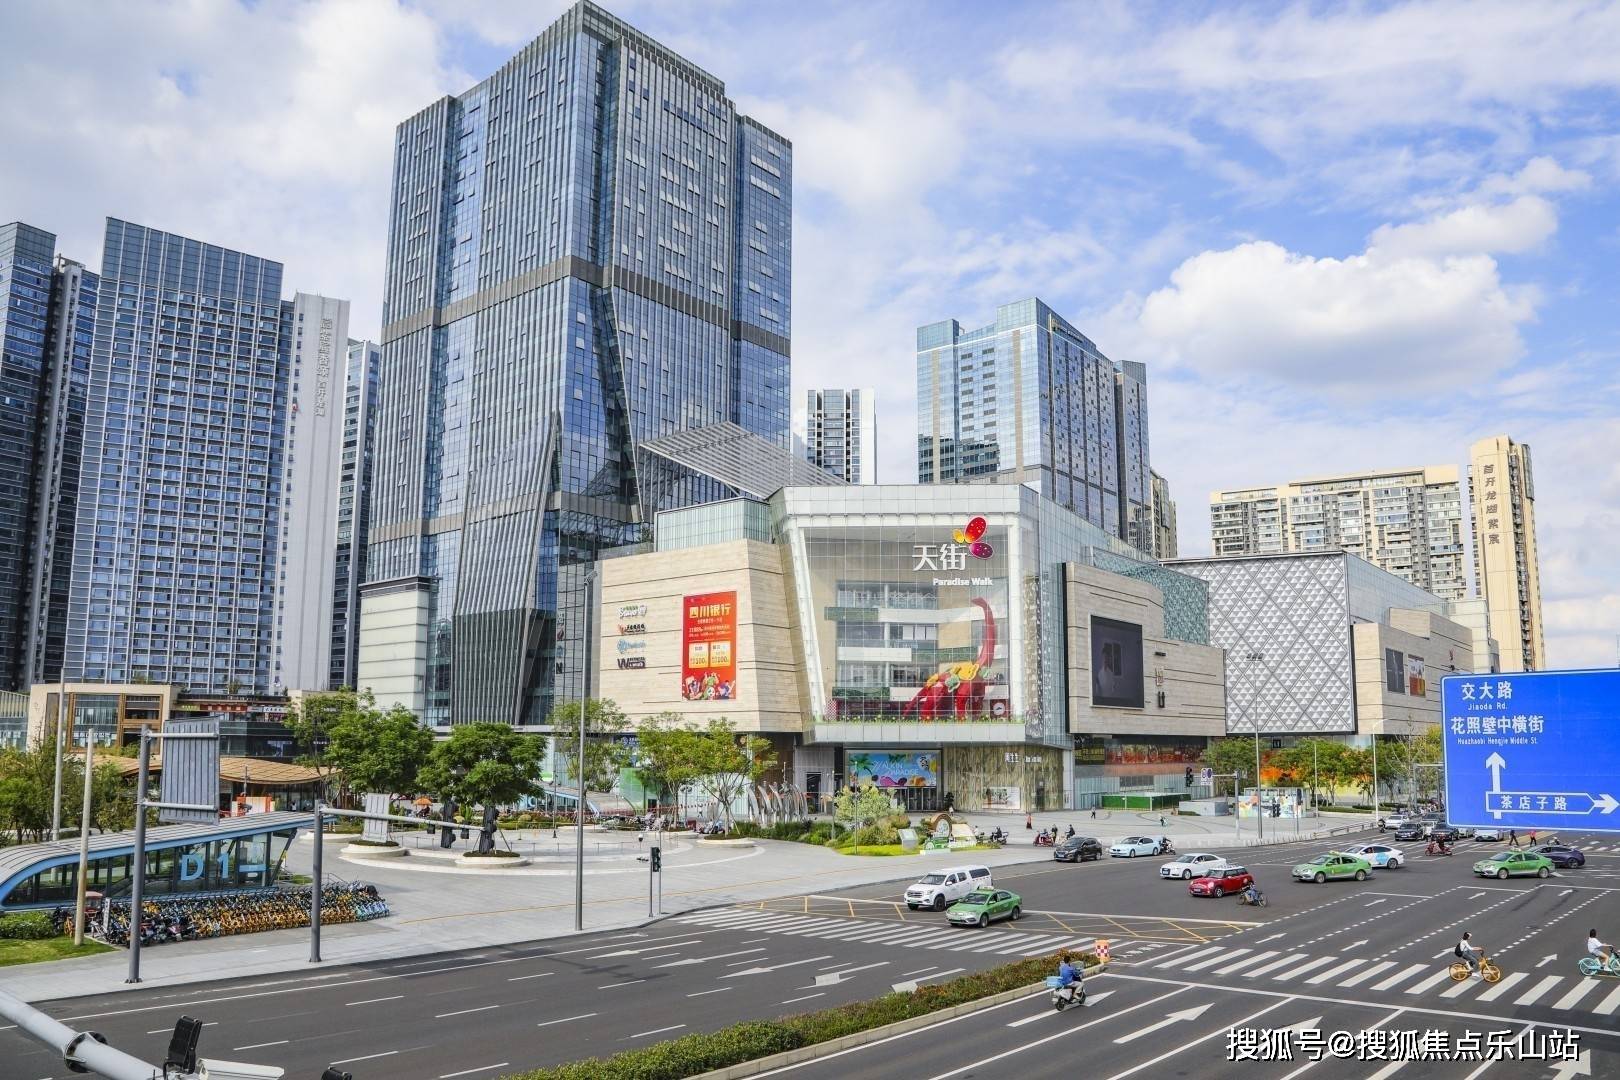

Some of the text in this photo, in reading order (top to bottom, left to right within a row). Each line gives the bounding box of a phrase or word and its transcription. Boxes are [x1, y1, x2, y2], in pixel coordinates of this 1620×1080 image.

[1483, 464, 1500, 545] 首开龙湖紫宸
[911, 543, 967, 571] 天街
[933, 577, 993, 586] Paradise Walk
[689, 604, 731, 619] 四川银行
[1461, 681, 1513, 700] 交大路
[1467, 702, 1508, 711] Jiaoda Rd.
[1450, 715, 1545, 735] 花照壁中横街
[1510, 737, 1528, 745] Middle
[1500, 795, 1568, 811] 茶店子路
